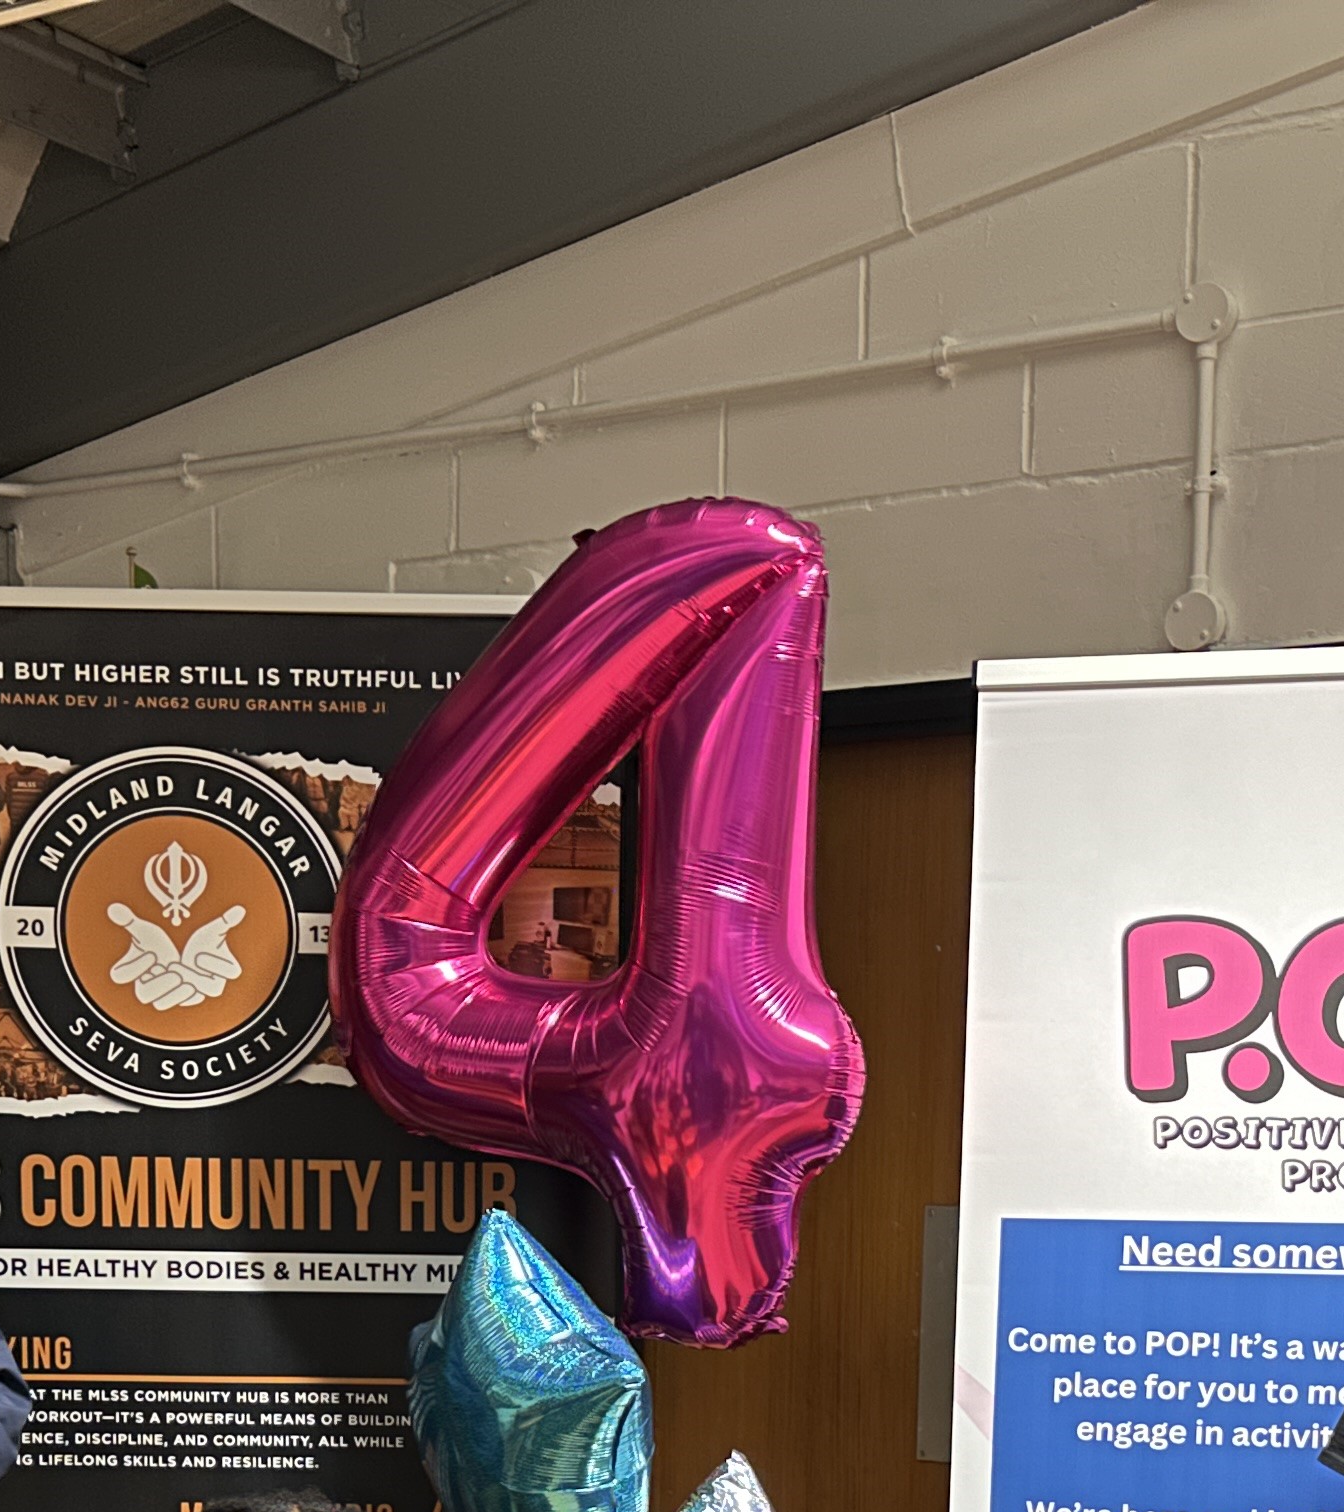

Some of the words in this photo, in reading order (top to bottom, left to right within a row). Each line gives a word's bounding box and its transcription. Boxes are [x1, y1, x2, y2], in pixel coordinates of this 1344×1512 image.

[15, 662, 64, 681] BUT
[74, 664, 170, 684] HIGHER
[180, 666, 248, 686] STILL
[258, 668, 280, 686] IS
[290, 668, 422, 689] TRUTHFUL
[1, 692, 59, 706] NANAK
[65, 694, 98, 707] DEV
[104, 696, 118, 708] JI
[135, 696, 189, 710] ANG62
[195, 697, 240, 711] GURU
[245, 698, 313, 713] GRANTH
[318, 700, 367, 714] SAHIB
[372, 702, 386, 714] JI
[39, 776, 175, 871] MIDLAND
[196, 779, 311, 878] LANGAR
[17, 918, 45, 937] 20
[68, 1017, 140, 1073] SEVA
[160, 1018, 288, 1081] SOCIETY
[20, 1153, 382, 1232] COMMUNITY
[399, 1160, 517, 1233] HUB
[1122, 1235, 1222, 1267] Need
[37, 1258, 158, 1279] HEALTHY
[166, 1259, 265, 1281] BODIES
[273, 1261, 290, 1281] &
[299, 1261, 416, 1283] HEALTHY
[425, 1264, 459, 1284] MI
[1008, 1326, 1095, 1354] Come
[1104, 1330, 1136, 1354] to
[1145, 1331, 1220, 1357] POP!
[1287, 1340, 1304, 1359] a
[52, 1389, 83, 1401] THE
[88, 1390, 129, 1402] MLSS
[134, 1390, 231, 1403] COMMUNITY
[236, 1391, 270, 1404] HUB
[274, 1392, 290, 1404] IS
[295, 1392, 340, 1404] MORE
[346, 1393, 389, 1405] THAN
[1053, 1371, 1136, 1403] place
[1144, 1374, 1190, 1399] for
[1197, 1382, 1256, 1408] you
[1265, 1378, 1298, 1403] to
[149, 1412, 160, 1424] A
[166, 1412, 255, 1425] POWERFUL
[260, 1413, 315, 1425] MEANS
[321, 1414, 343, 1426] OF
[74, 1433, 169, 1448] DISCIPLINE,
[173, 1434, 208, 1447] AND
[213, 1434, 313, 1449] COMMUNITY,
[318, 1435, 348, 1447] ALL
[354, 1436, 404, 1448] WHILE
[1076, 1420, 1187, 1450] engage
[1195, 1419, 1223, 1446] in
[39, 1454, 118, 1467] LIFELONG
[123, 1455, 177, 1467] SKILLS
[182, 1455, 216, 1468] AND
[221, 1456, 320, 1469] RESILIENCE.
